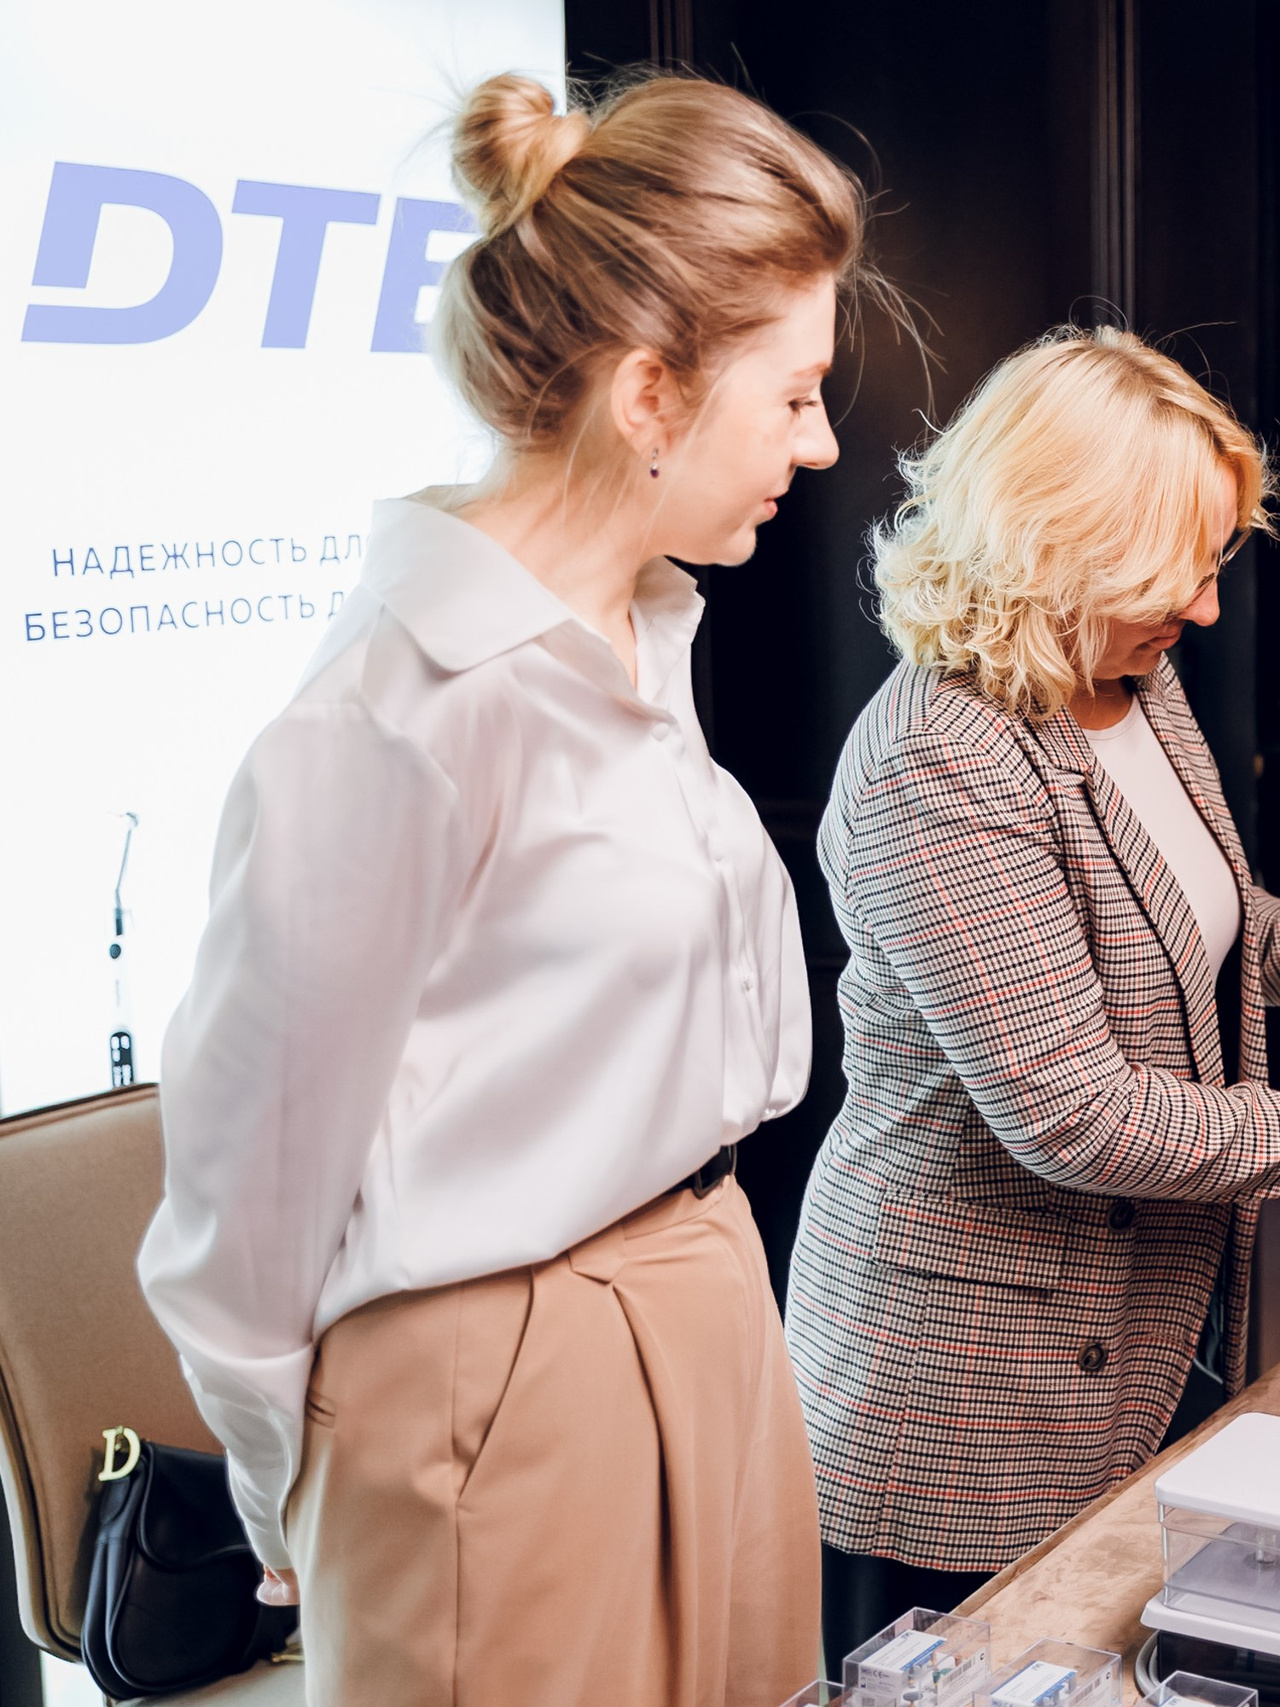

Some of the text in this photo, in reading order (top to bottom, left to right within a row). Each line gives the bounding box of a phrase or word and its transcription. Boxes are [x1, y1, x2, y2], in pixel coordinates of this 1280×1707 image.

[52, 534, 370, 580] НАДЕЖНОСТЬ ДЛ
[24, 594, 315, 642] БЕЗОПАСНОСТЬ
